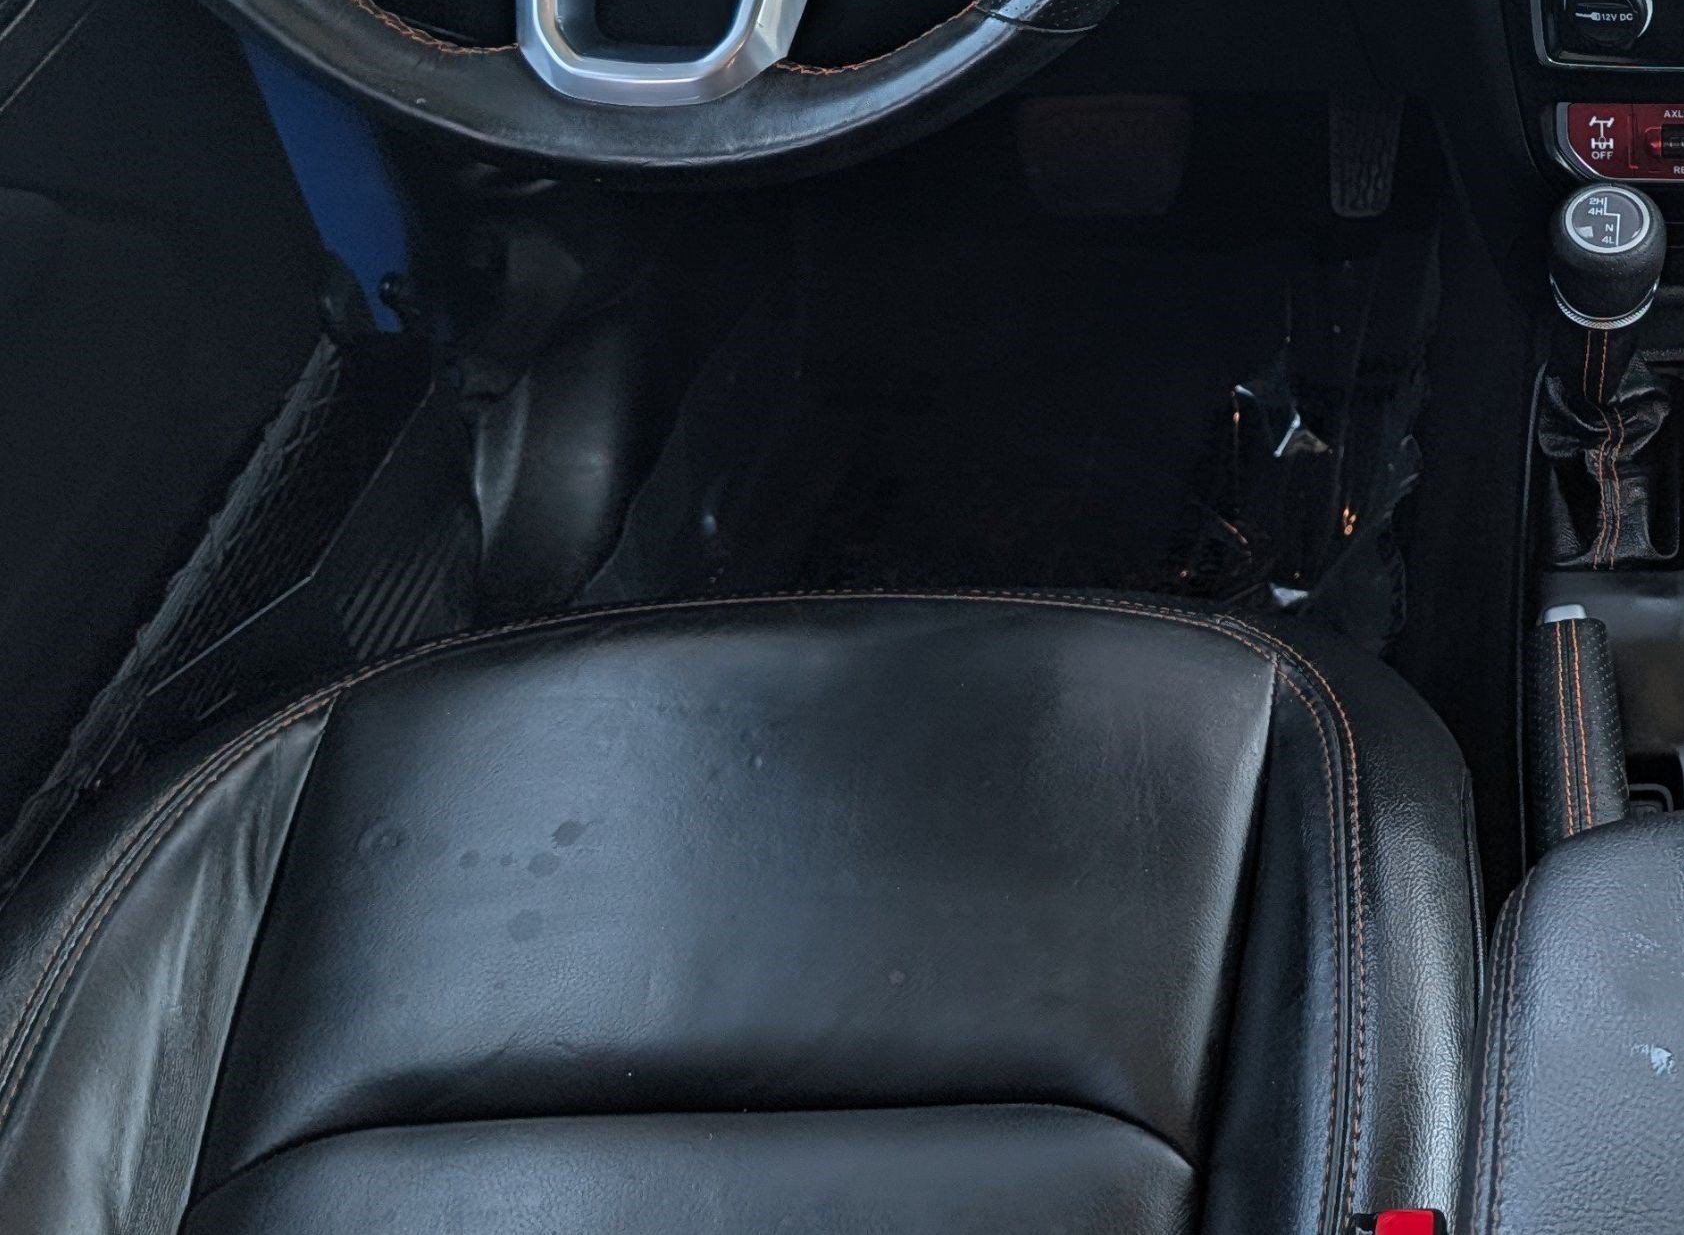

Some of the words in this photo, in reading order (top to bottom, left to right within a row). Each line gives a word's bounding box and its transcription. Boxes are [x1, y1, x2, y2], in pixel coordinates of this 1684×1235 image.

[1601, 13, 1618, 22] 12V
[1619, 13, 1634, 22] DC
[1591, 151, 1613, 160] OFF
[1588, 197, 1604, 205] 2H
[1587, 207, 1604, 216] 4H
[1605, 224, 1614, 232] N
[1601, 236, 1615, 244] 4L
